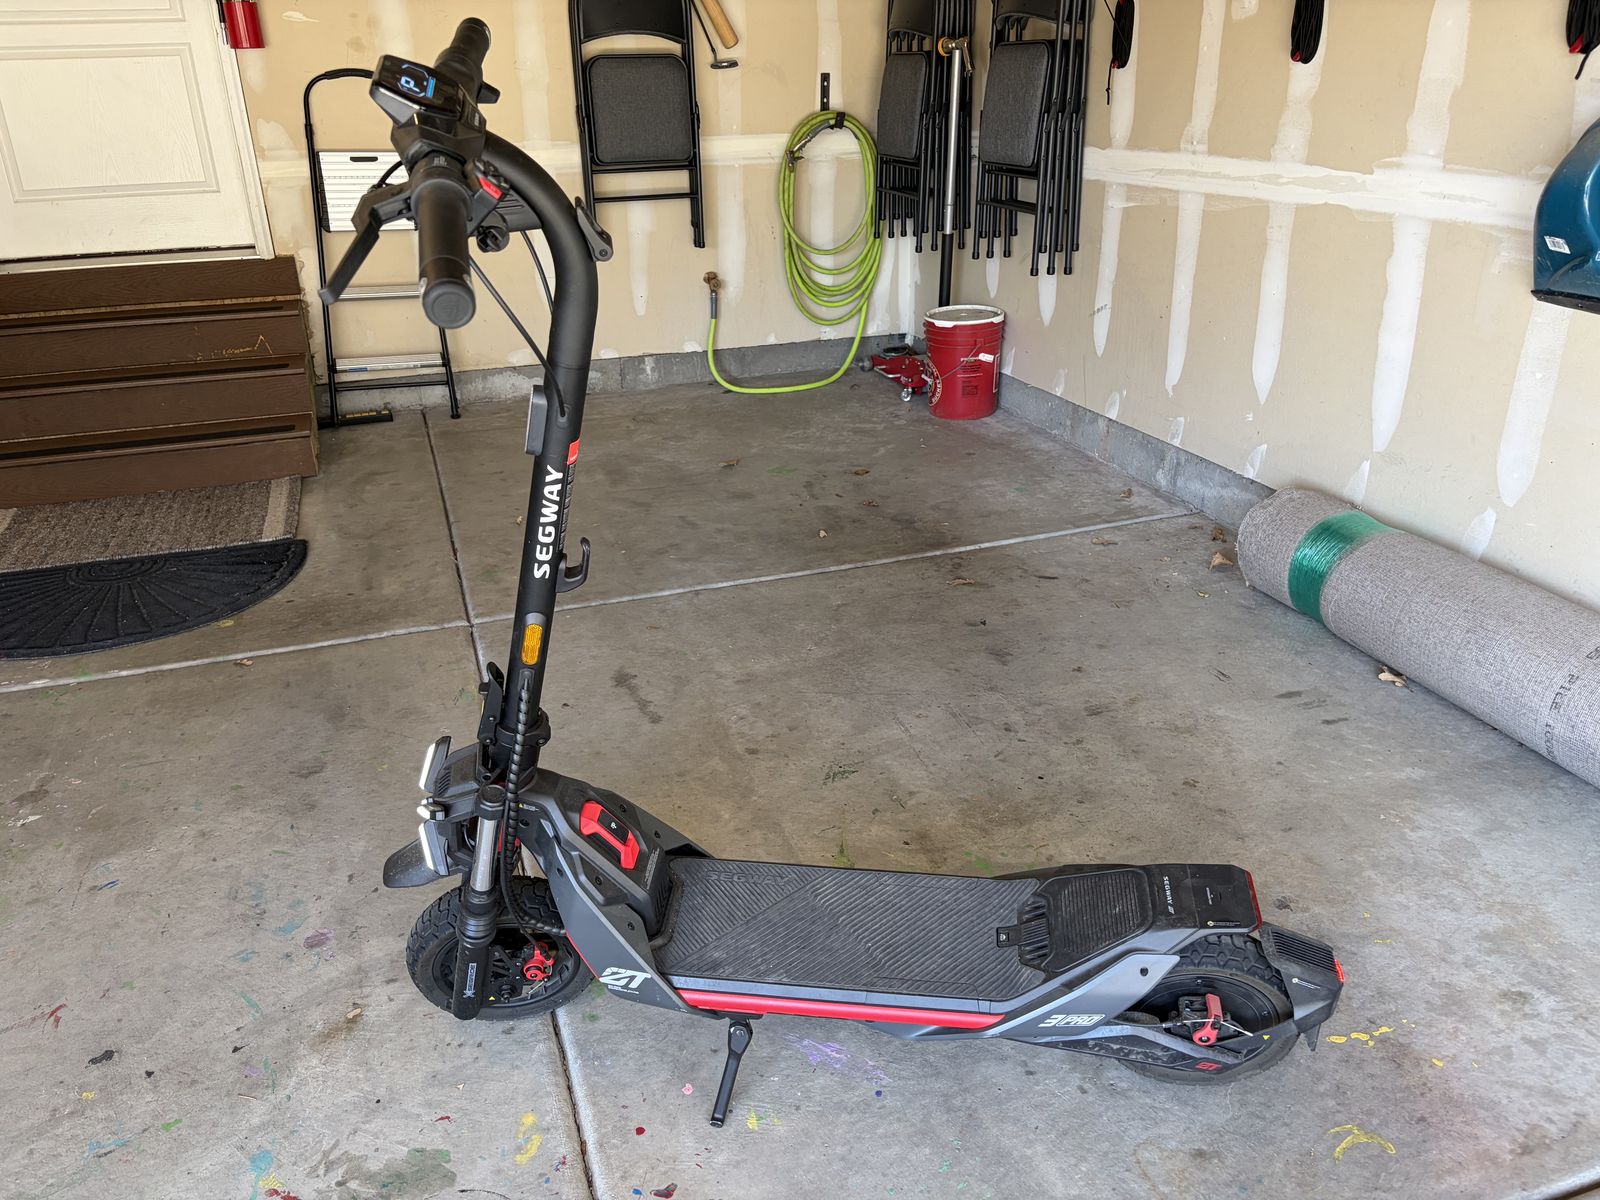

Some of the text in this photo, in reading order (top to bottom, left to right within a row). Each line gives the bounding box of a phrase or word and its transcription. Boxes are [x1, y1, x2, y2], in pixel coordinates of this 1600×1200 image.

[533, 464, 564, 579] SEGWAY
[703, 871, 793, 886] SEGWAY
[1163, 876, 1173, 905] SEGWAY
[1038, 1014, 1103, 1027] 3 PRO
